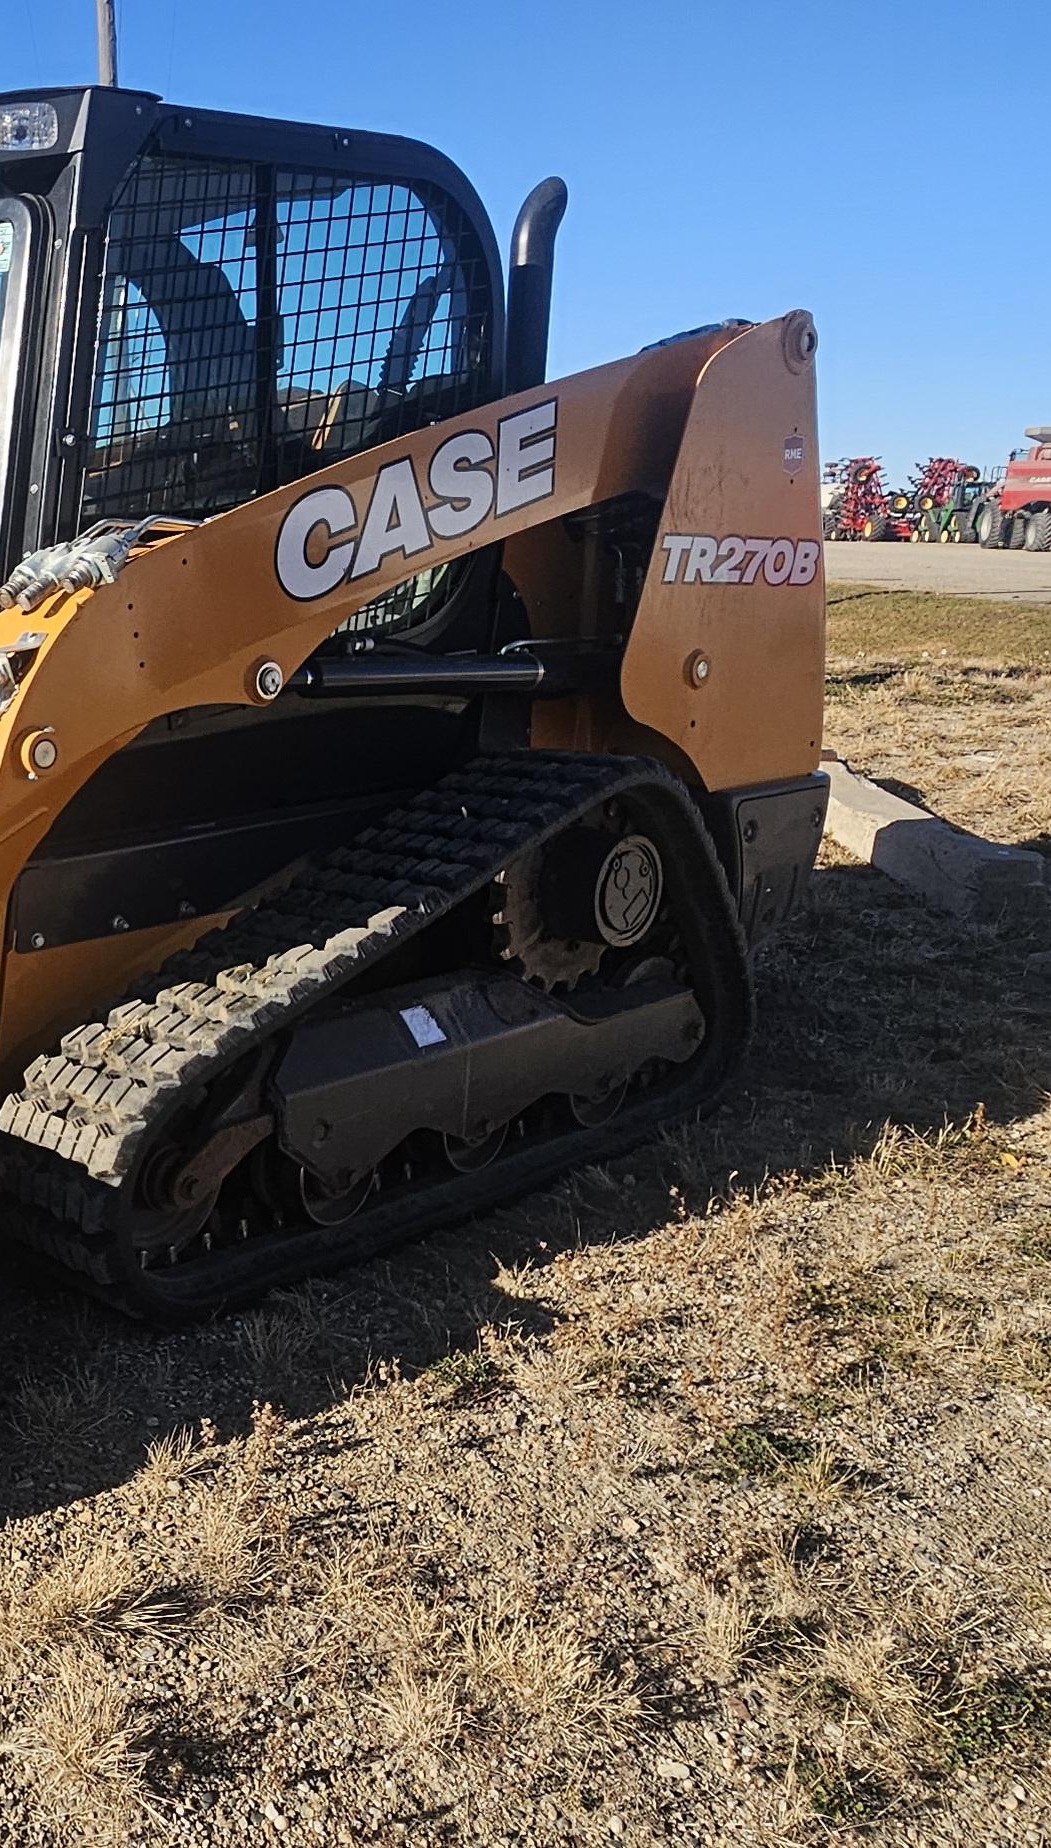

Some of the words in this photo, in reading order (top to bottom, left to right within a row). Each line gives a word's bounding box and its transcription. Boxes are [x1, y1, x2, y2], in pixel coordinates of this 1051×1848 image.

[784, 448, 802, 460] RME
[274, 396, 558, 602] CASE
[662, 533, 821, 586] TR270B
